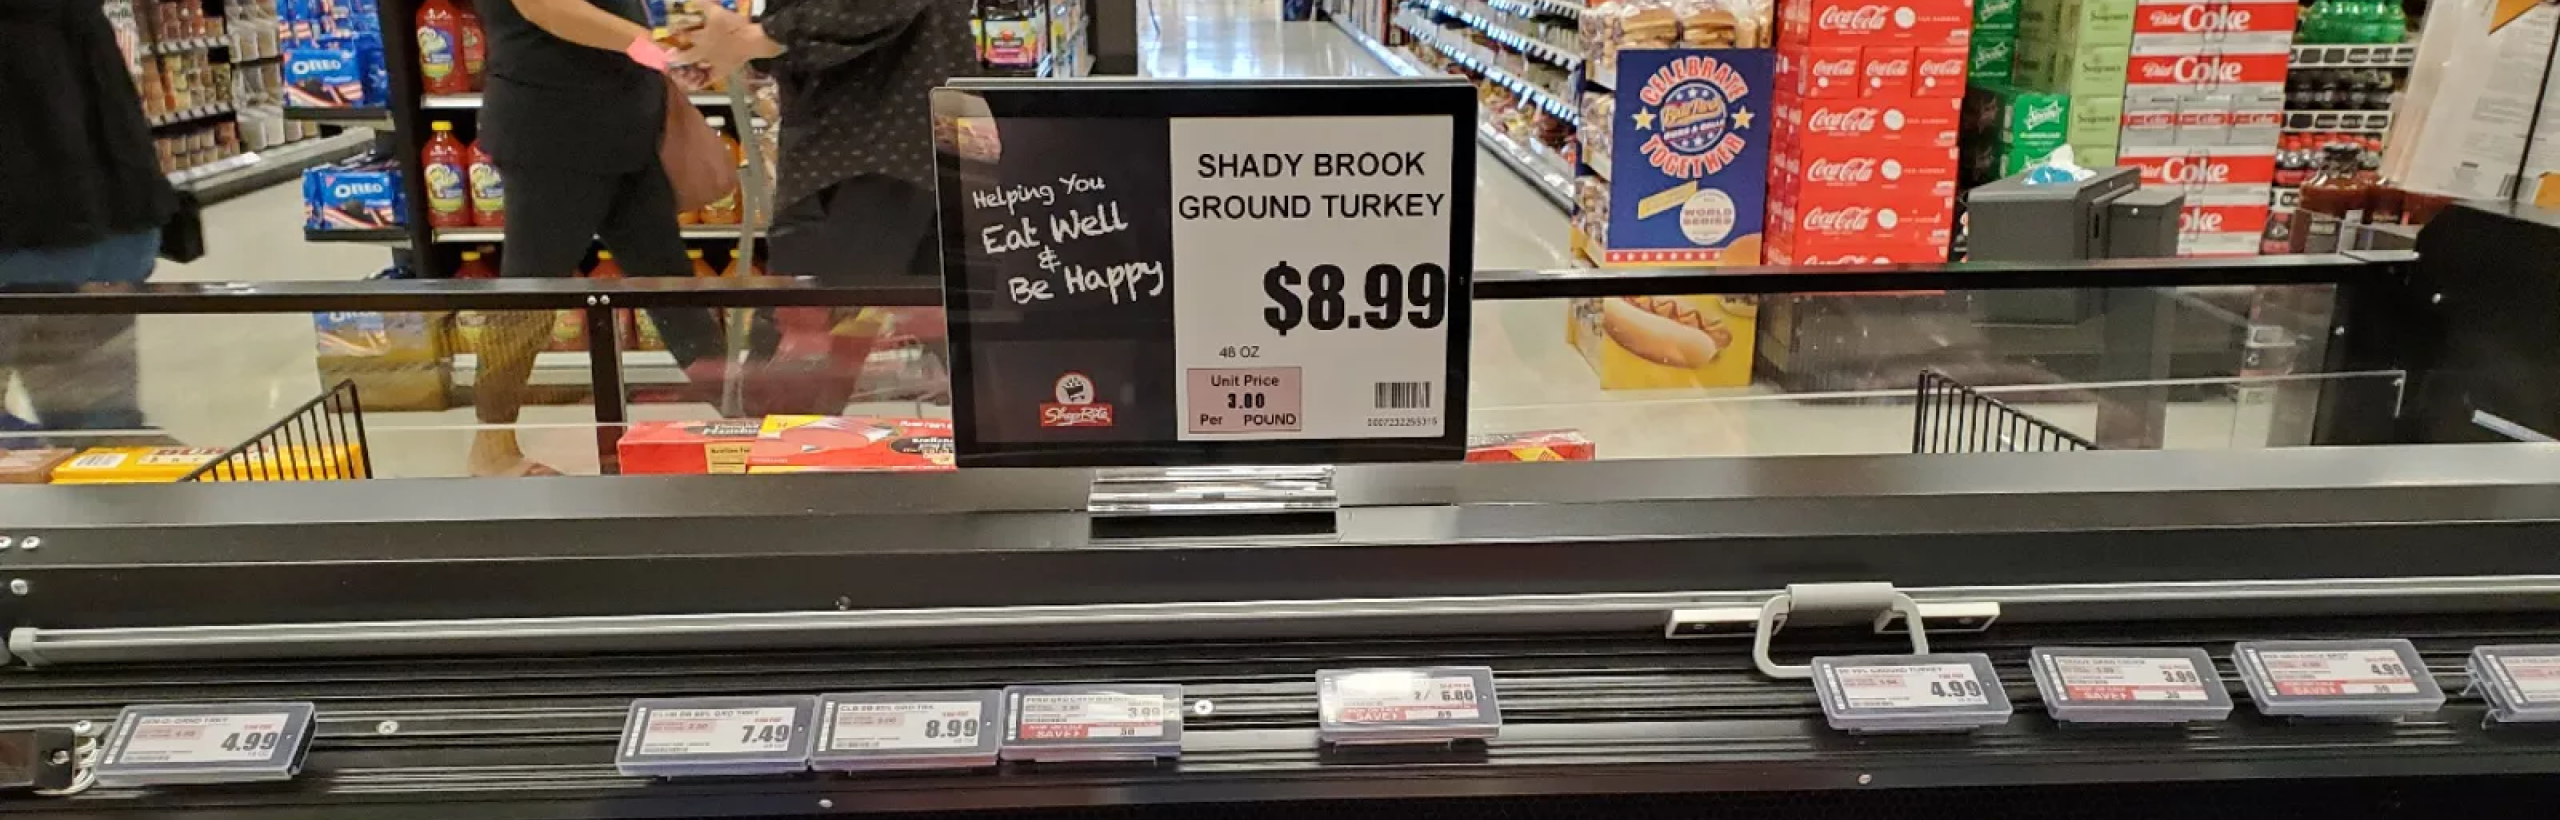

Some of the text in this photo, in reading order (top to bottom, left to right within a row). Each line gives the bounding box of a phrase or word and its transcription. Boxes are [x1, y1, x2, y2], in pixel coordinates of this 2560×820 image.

[2182, 4, 2251, 32] Coke
[292, 59, 342, 75] OREO
[2174, 55, 2243, 82] Coke
[1640, 56, 1749, 106] CELEBRATE
[1197, 151, 1426, 178] SHADY BROOK
[1640, 132, 1746, 179] TOGETHER
[2162, 157, 2230, 183] Coke
[335, 182, 384, 198] OREO
[973, 173, 1106, 216] Helping You
[1179, 193, 1445, 219] GROUND TURKEY
[982, 201, 1129, 254] Eat Well
[2180, 207, 2223, 232] oke
[1037, 245, 1062, 274] &
[1008, 261, 1164, 305] Be Happy
[1263, 261, 1447, 336] $8.99
[1219, 345, 1260, 358] 48 OZ
[1211, 374, 1280, 387] Unit Price
[1200, 412, 1297, 426] Per POUND
[2162, 670, 2196, 683] 3.99
[2371, 663, 2405, 676] 4.99
[1931, 680, 1982, 698] 4.99
[742, 724, 790, 744] 7.49
[925, 718, 979, 738] 8.99
[221, 732, 278, 751] 4.99
